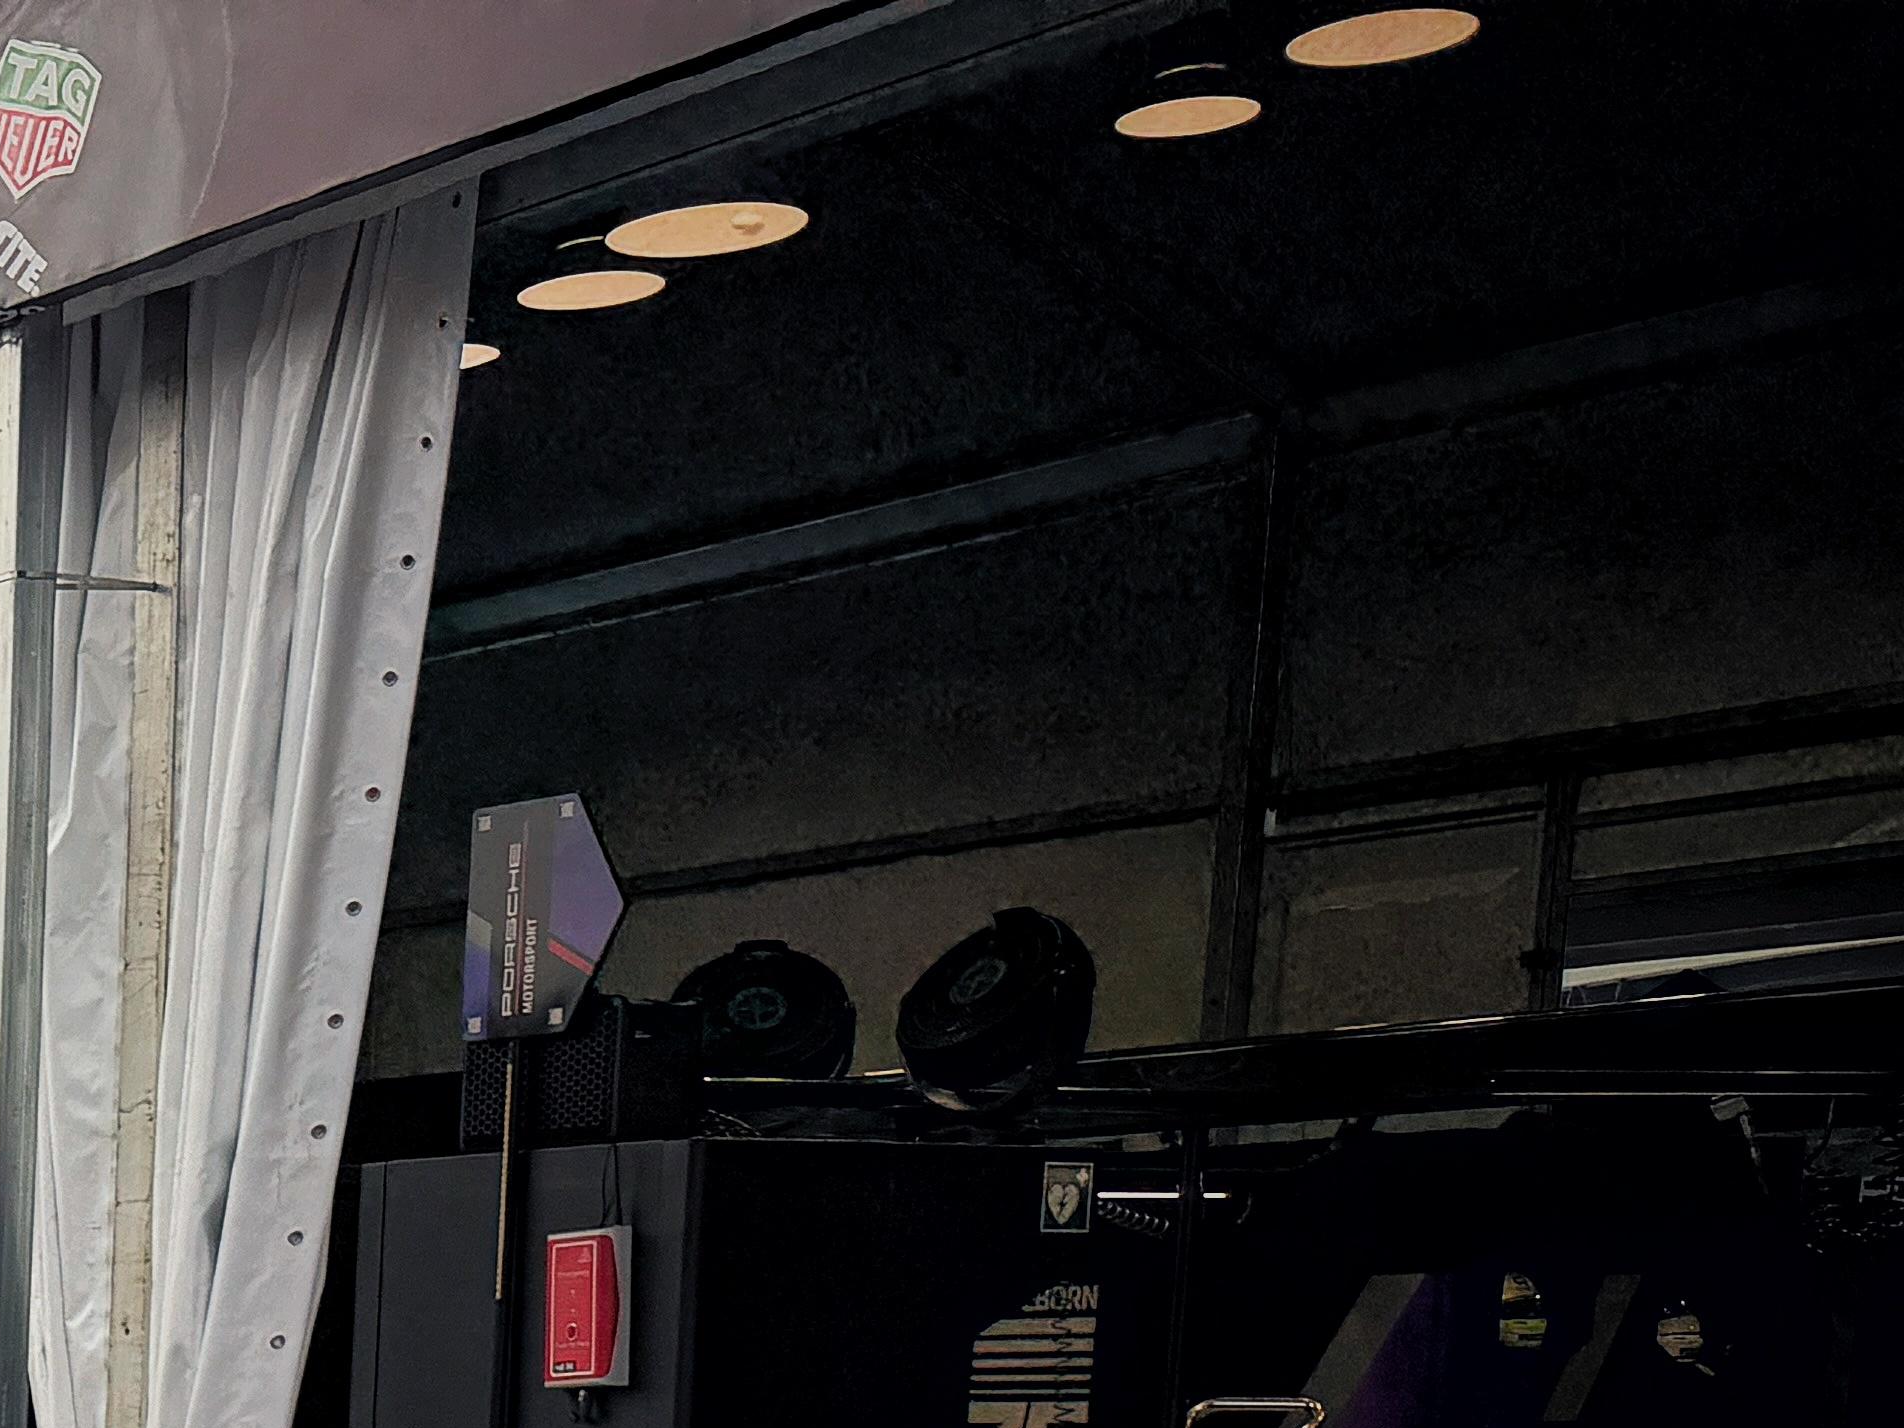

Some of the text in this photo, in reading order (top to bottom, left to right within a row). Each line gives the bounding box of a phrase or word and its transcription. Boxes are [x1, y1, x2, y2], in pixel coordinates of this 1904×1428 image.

[7, 53, 91, 118] TAG
[501, 842, 522, 1018] PORSCHE
[522, 917, 539, 1015] MOTORSPORT
